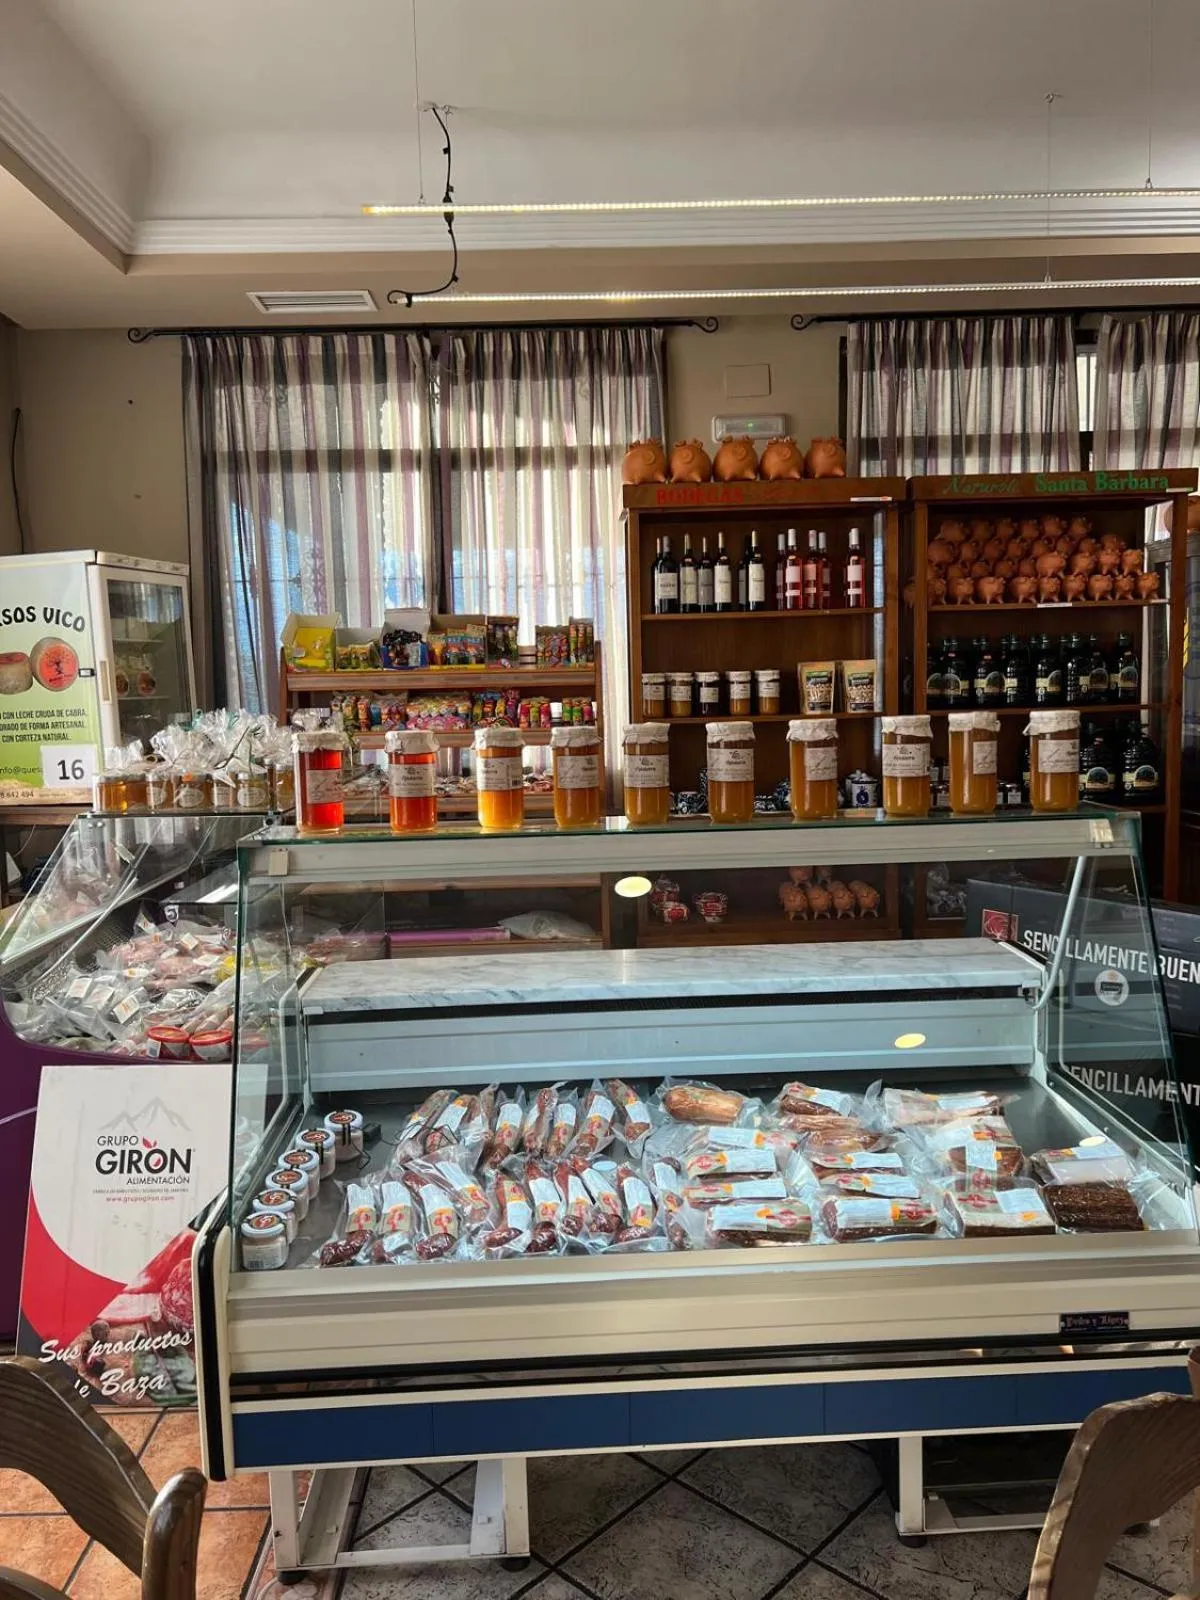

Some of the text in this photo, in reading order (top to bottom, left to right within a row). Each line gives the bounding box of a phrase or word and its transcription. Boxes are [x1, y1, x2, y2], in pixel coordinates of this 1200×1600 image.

[1036, 473, 1087, 492] Santa
[0, 606, 85, 632] SOS VICO
[15, 710, 34, 719] LECHE
[15, 733, 42, 743] CORTEZA
[57, 759, 84, 780] 16
[1023, 929, 1148, 973] SENCLLAMENTE
[1066, 1065, 1200, 1106] ENCILLAMENT
[97, 1135, 139, 1146] GRUPO
[126, 1175, 190, 1185] ALIMENTACIÓN
[38, 1330, 193, 1364] Sus productos
[100, 1368, 167, 1400] Baza
